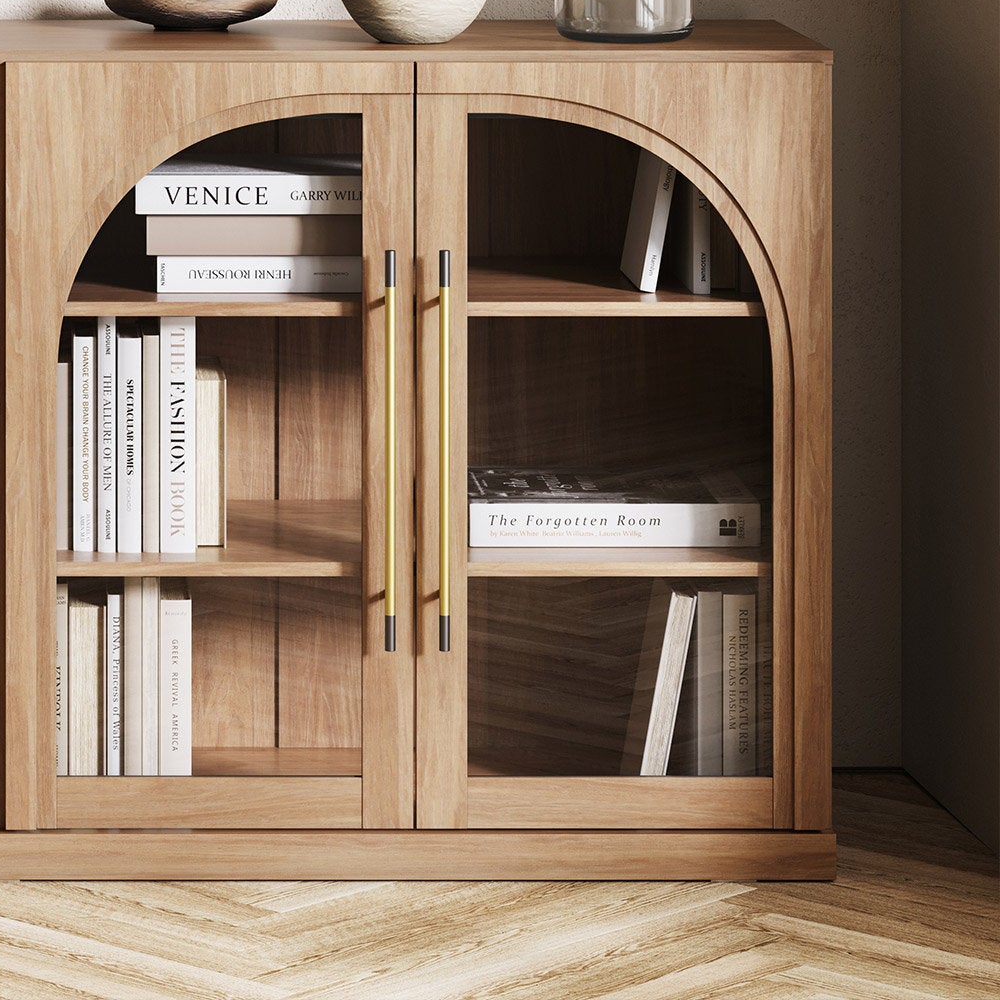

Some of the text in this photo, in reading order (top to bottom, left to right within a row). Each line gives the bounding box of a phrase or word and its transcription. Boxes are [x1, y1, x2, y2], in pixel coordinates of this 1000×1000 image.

[164, 186, 269, 206] VENICE
[290, 190, 332, 202] GARRY
[188, 270, 292, 280] HENRI ROUSSEAU
[126, 379, 134, 441] SPECTACULAR
[103, 374, 112, 491] THE ALLURE OF MEN
[170, 328, 186, 536] THE FASHION BOOK
[126, 444, 134, 476] HOMES
[489, 514, 662, 530] The Forgotten Room
[112, 616, 120, 654] DIANA,
[739, 609, 748, 754] REDEEMING FEATURES
[113, 706, 120, 716] of
[112, 720, 120, 750] Wales
